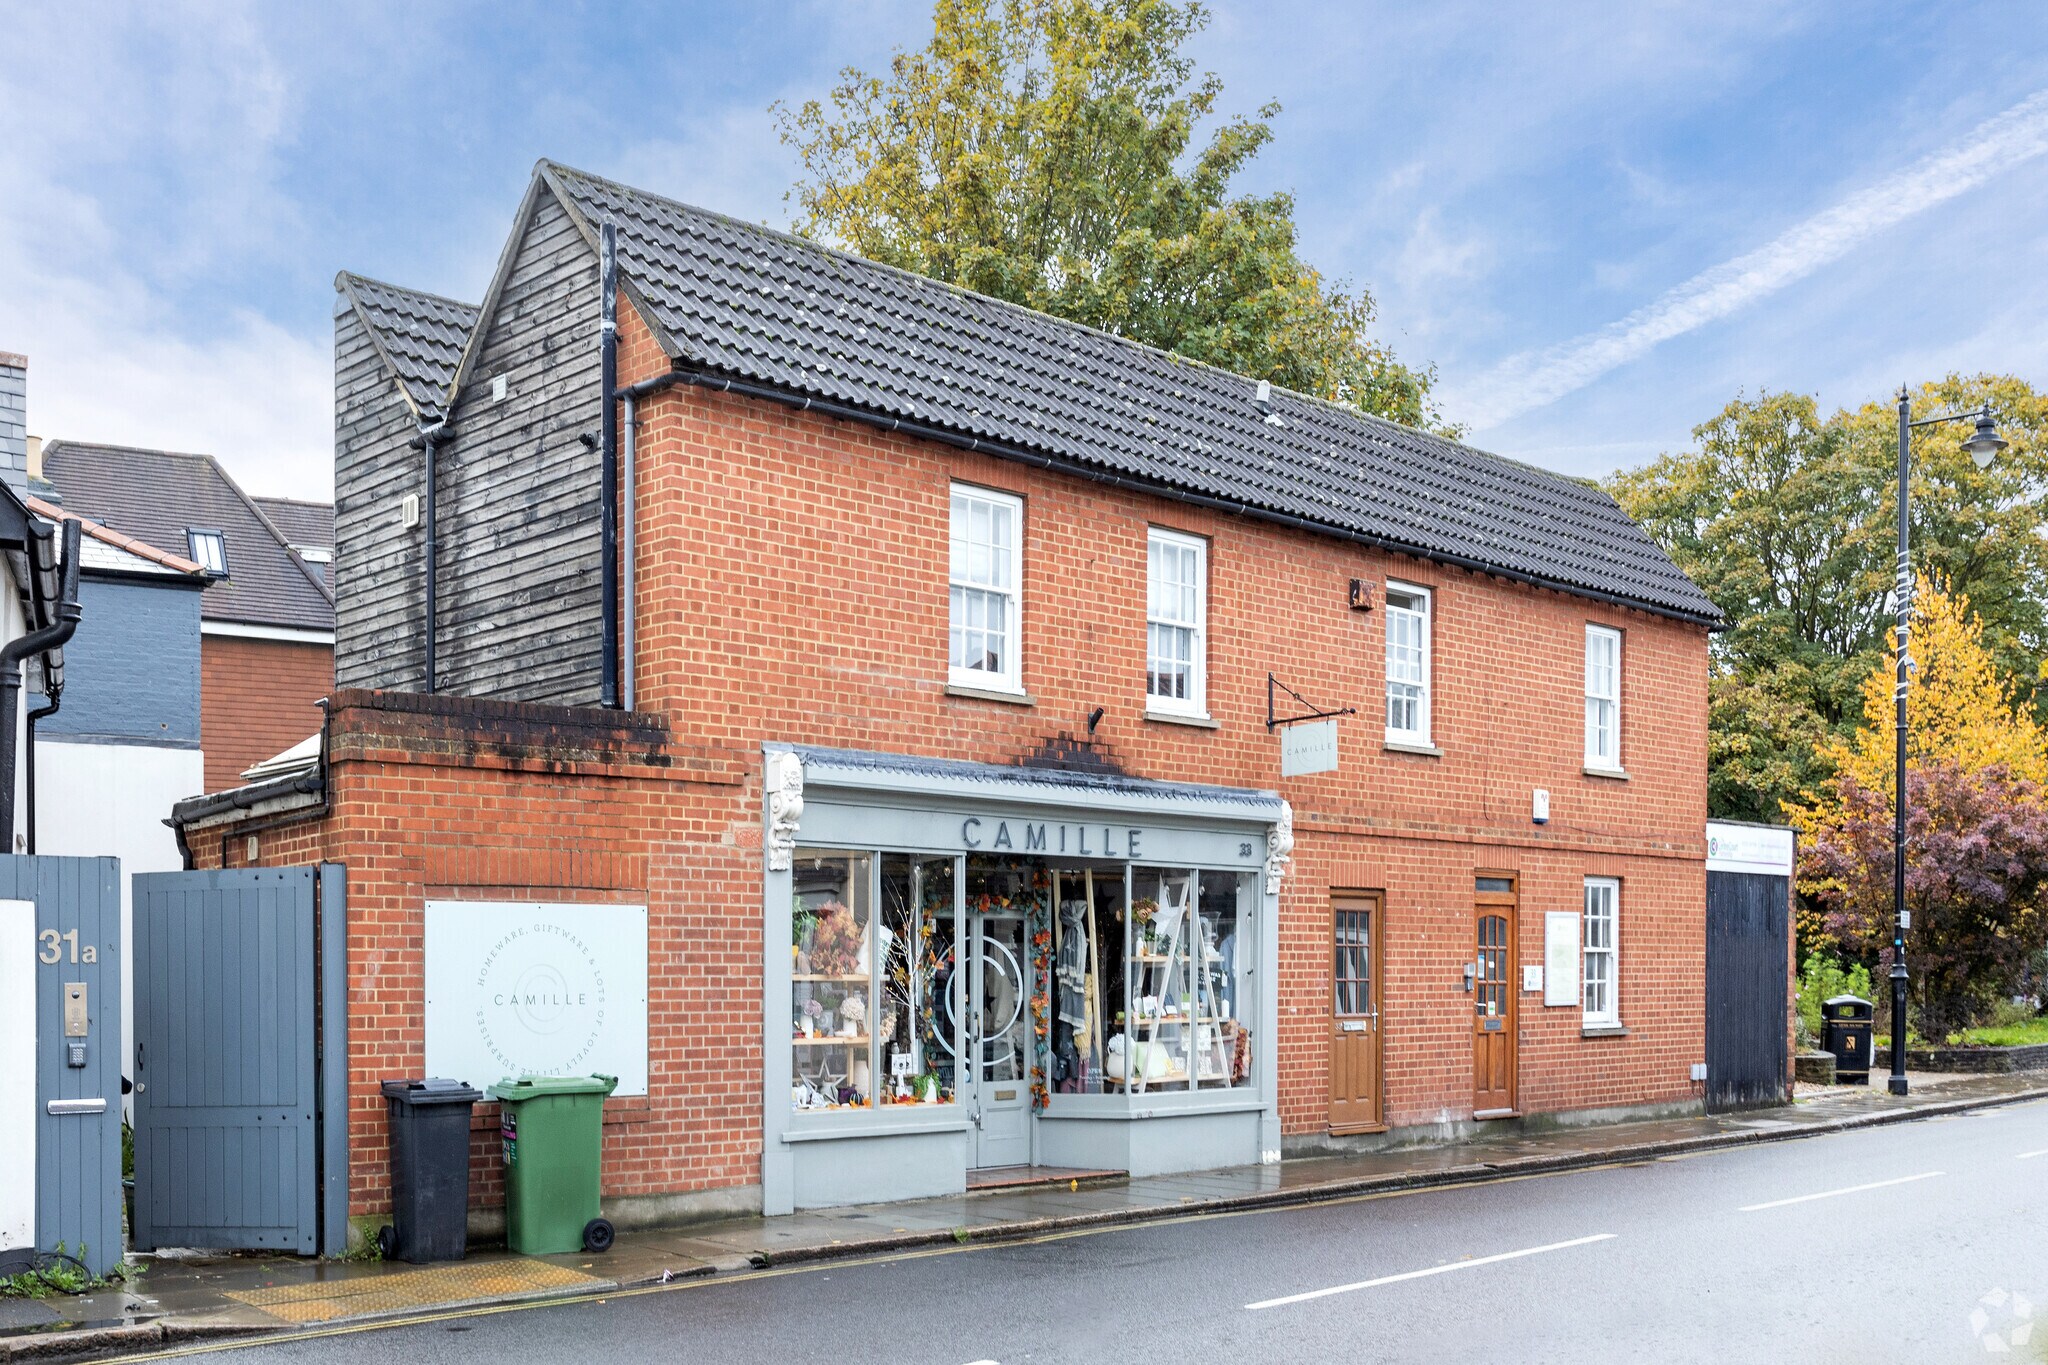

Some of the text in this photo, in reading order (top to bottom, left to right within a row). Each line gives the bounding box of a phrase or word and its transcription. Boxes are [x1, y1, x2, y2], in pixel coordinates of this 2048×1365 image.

[1286, 742, 1333, 757] CAMILLE
[962, 817, 1143, 858] CAMILLE
[1239, 844, 1252, 857] 33
[39, 929, 96, 964] 31a
[534, 924, 589, 955] GIFTWARE
[494, 993, 586, 1006] CAMILLE
[594, 970, 605, 1003] LOTS
[595, 1010, 605, 1027] OF
[566, 1032, 598, 1071] LOVELY
